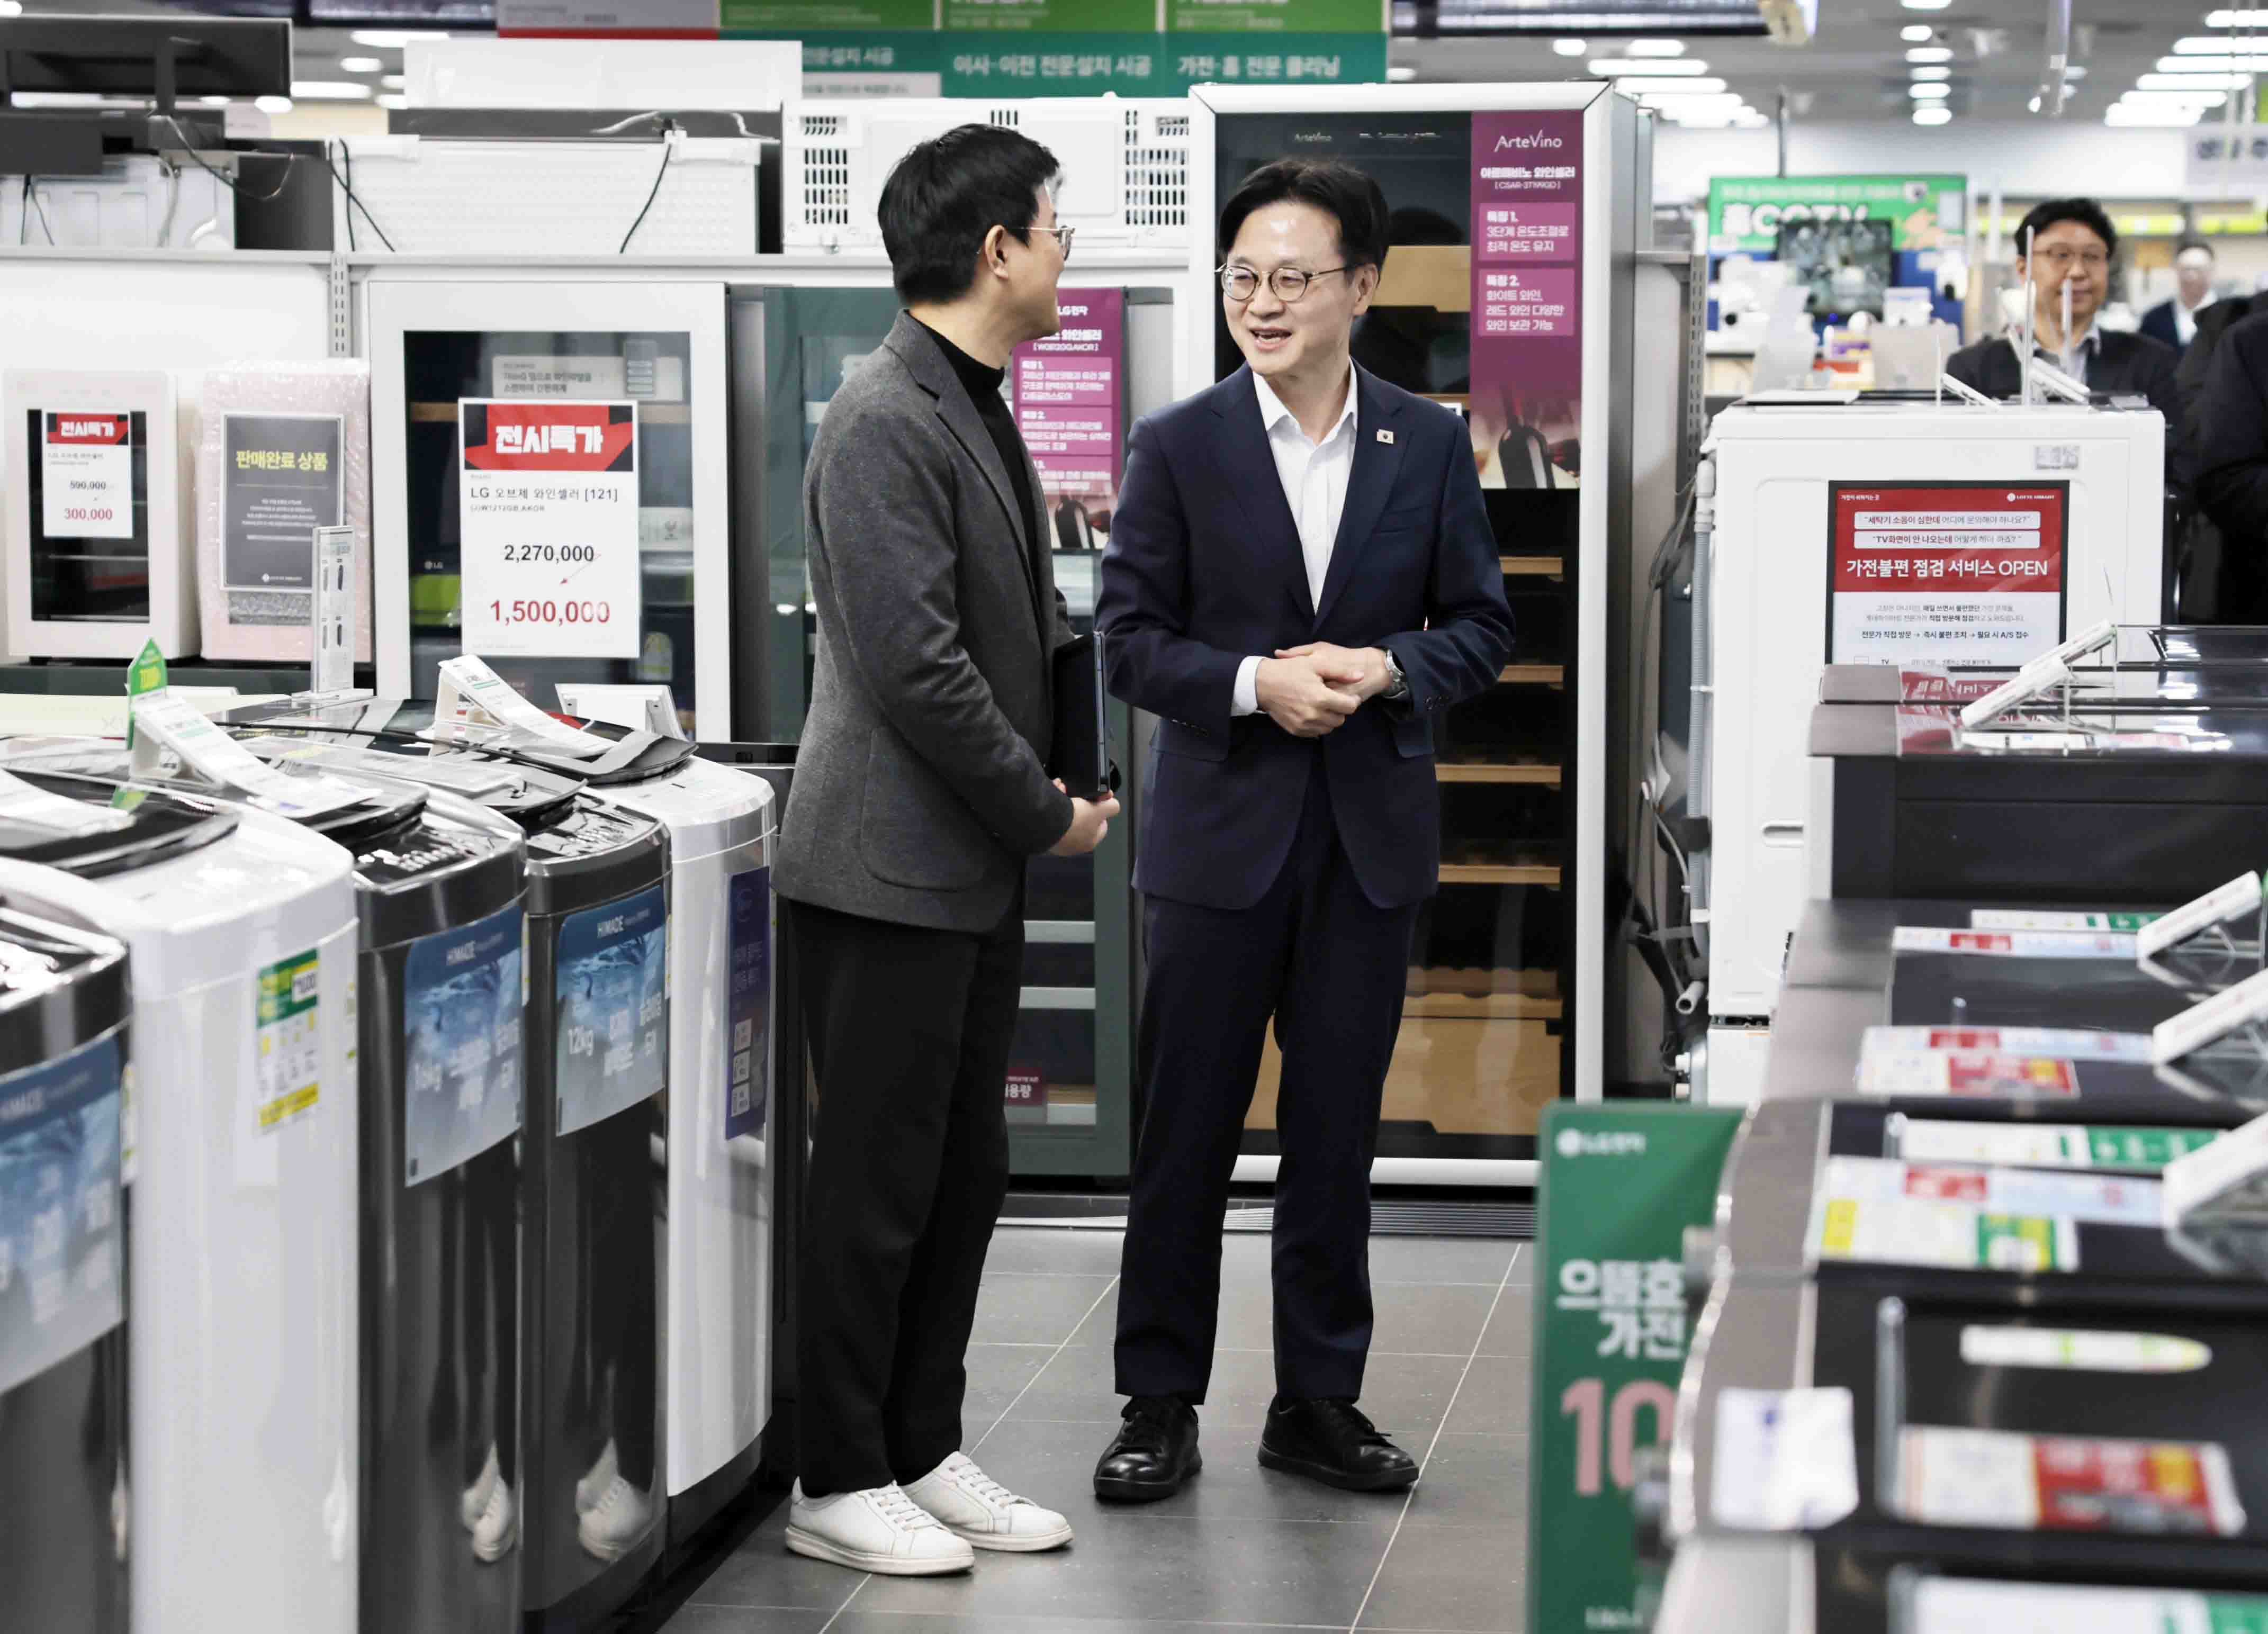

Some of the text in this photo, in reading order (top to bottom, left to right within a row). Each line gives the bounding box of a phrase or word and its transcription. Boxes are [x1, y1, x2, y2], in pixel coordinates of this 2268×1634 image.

[1041, 55, 1111, 78] 전문설치
[1116, 55, 1151, 79] 시공
[1246, 55, 1282, 78] 전문
[1286, 55, 1340, 78] 클리닝
[1494, 129, 1562, 152] ArteVino
[1510, 241, 1531, 252] 온도
[1487, 290, 1516, 301] 화이트
[1486, 304, 1564, 317] 레드 와인 다양한
[1486, 320, 1554, 331] 와인 보관 가능
[60, 421, 115, 437] 전시특가
[496, 425, 603, 454] 전시특가
[236, 450, 328, 471] 판매완료 상품
[471, 487, 618, 502] LG 오브제 와인셀러 [121]
[64, 508, 113, 521] 300,000
[1893, 516, 1916, 525] 소음이
[1918, 516, 1941, 525] 심한데
[1941, 516, 1965, 525] 어디에
[1967, 516, 1997, 525] 문의해야
[1912, 535, 1921, 544] 안
[1922, 535, 1952, 544] 나오는데
[504, 545, 595, 563] 2,270,000
[1846, 558, 2048, 578] 가전불편 점검 서비스 OPEN
[490, 600, 610, 624] 1,500,000
[1597, 1310, 1686, 1360] 가전
